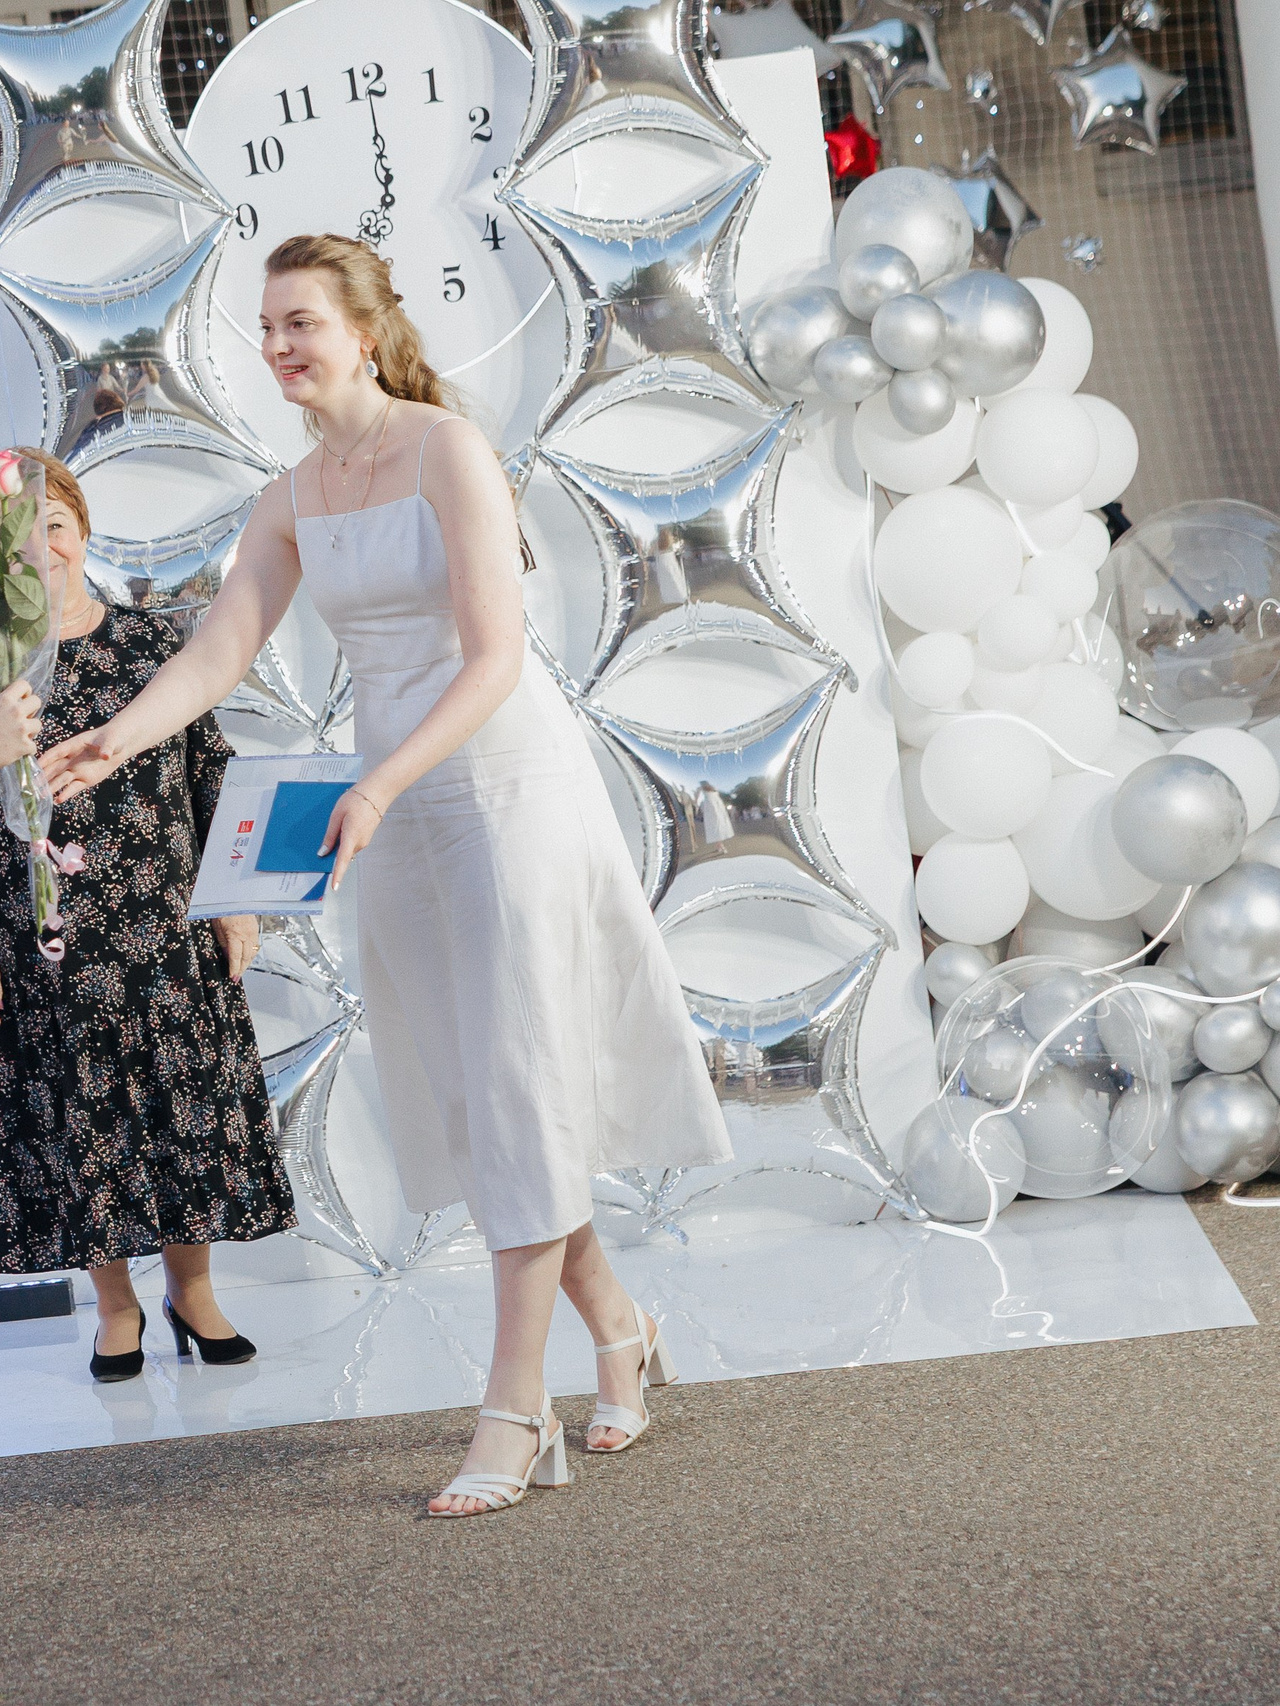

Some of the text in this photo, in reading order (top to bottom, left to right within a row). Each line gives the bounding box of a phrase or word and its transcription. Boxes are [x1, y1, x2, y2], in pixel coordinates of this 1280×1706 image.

[342, 62, 387, 103] 12
[422, 67, 444, 104] 1
[274, 84, 321, 126] 11
[469, 106, 493, 144] 2
[241, 136, 284, 178] 10
[235, 203, 259, 240] 9
[480, 213, 506, 252] 4
[442, 264, 466, 303] 5
